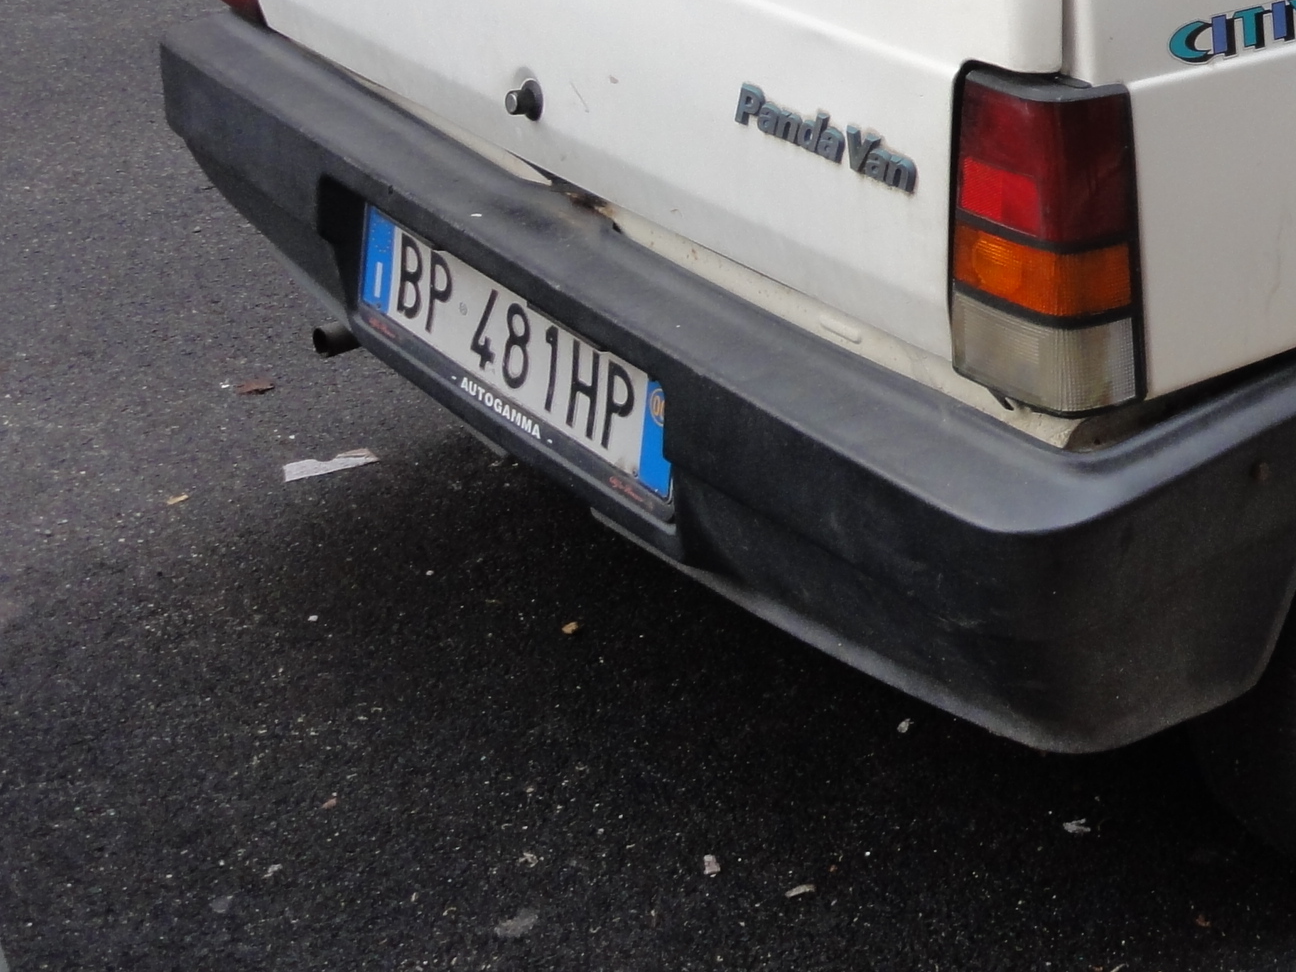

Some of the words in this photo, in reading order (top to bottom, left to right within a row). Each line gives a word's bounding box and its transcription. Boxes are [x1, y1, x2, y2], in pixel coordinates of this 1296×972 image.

[734, 81, 846, 165] Panda
[846, 124, 918, 194] Van
[396, 232, 453, 334] BP
[470, 289, 635, 451] 481HP
[460, 376, 542, 440] AUTOGAMMA
